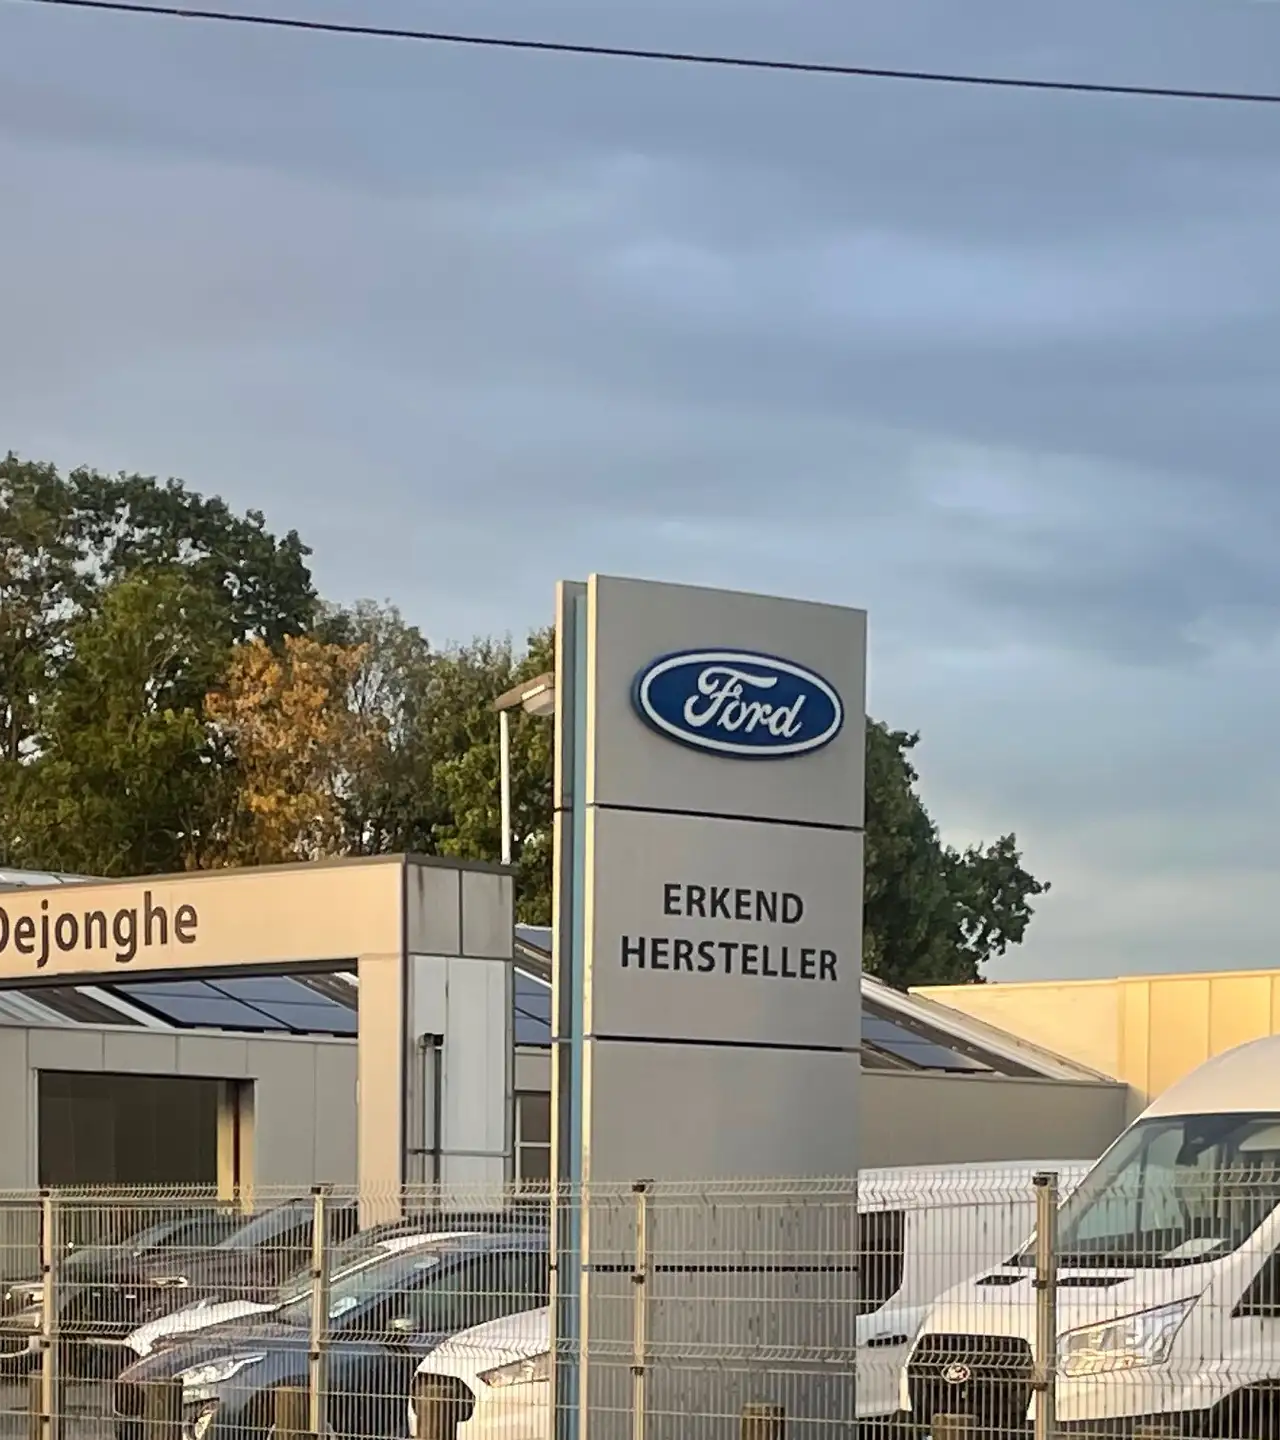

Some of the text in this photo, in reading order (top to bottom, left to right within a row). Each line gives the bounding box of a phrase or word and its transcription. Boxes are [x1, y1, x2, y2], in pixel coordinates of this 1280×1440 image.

[683, 666, 805, 738] Ford
[663, 883, 803, 924] ERKEND
[621, 936, 837, 981] HERSTELLER
